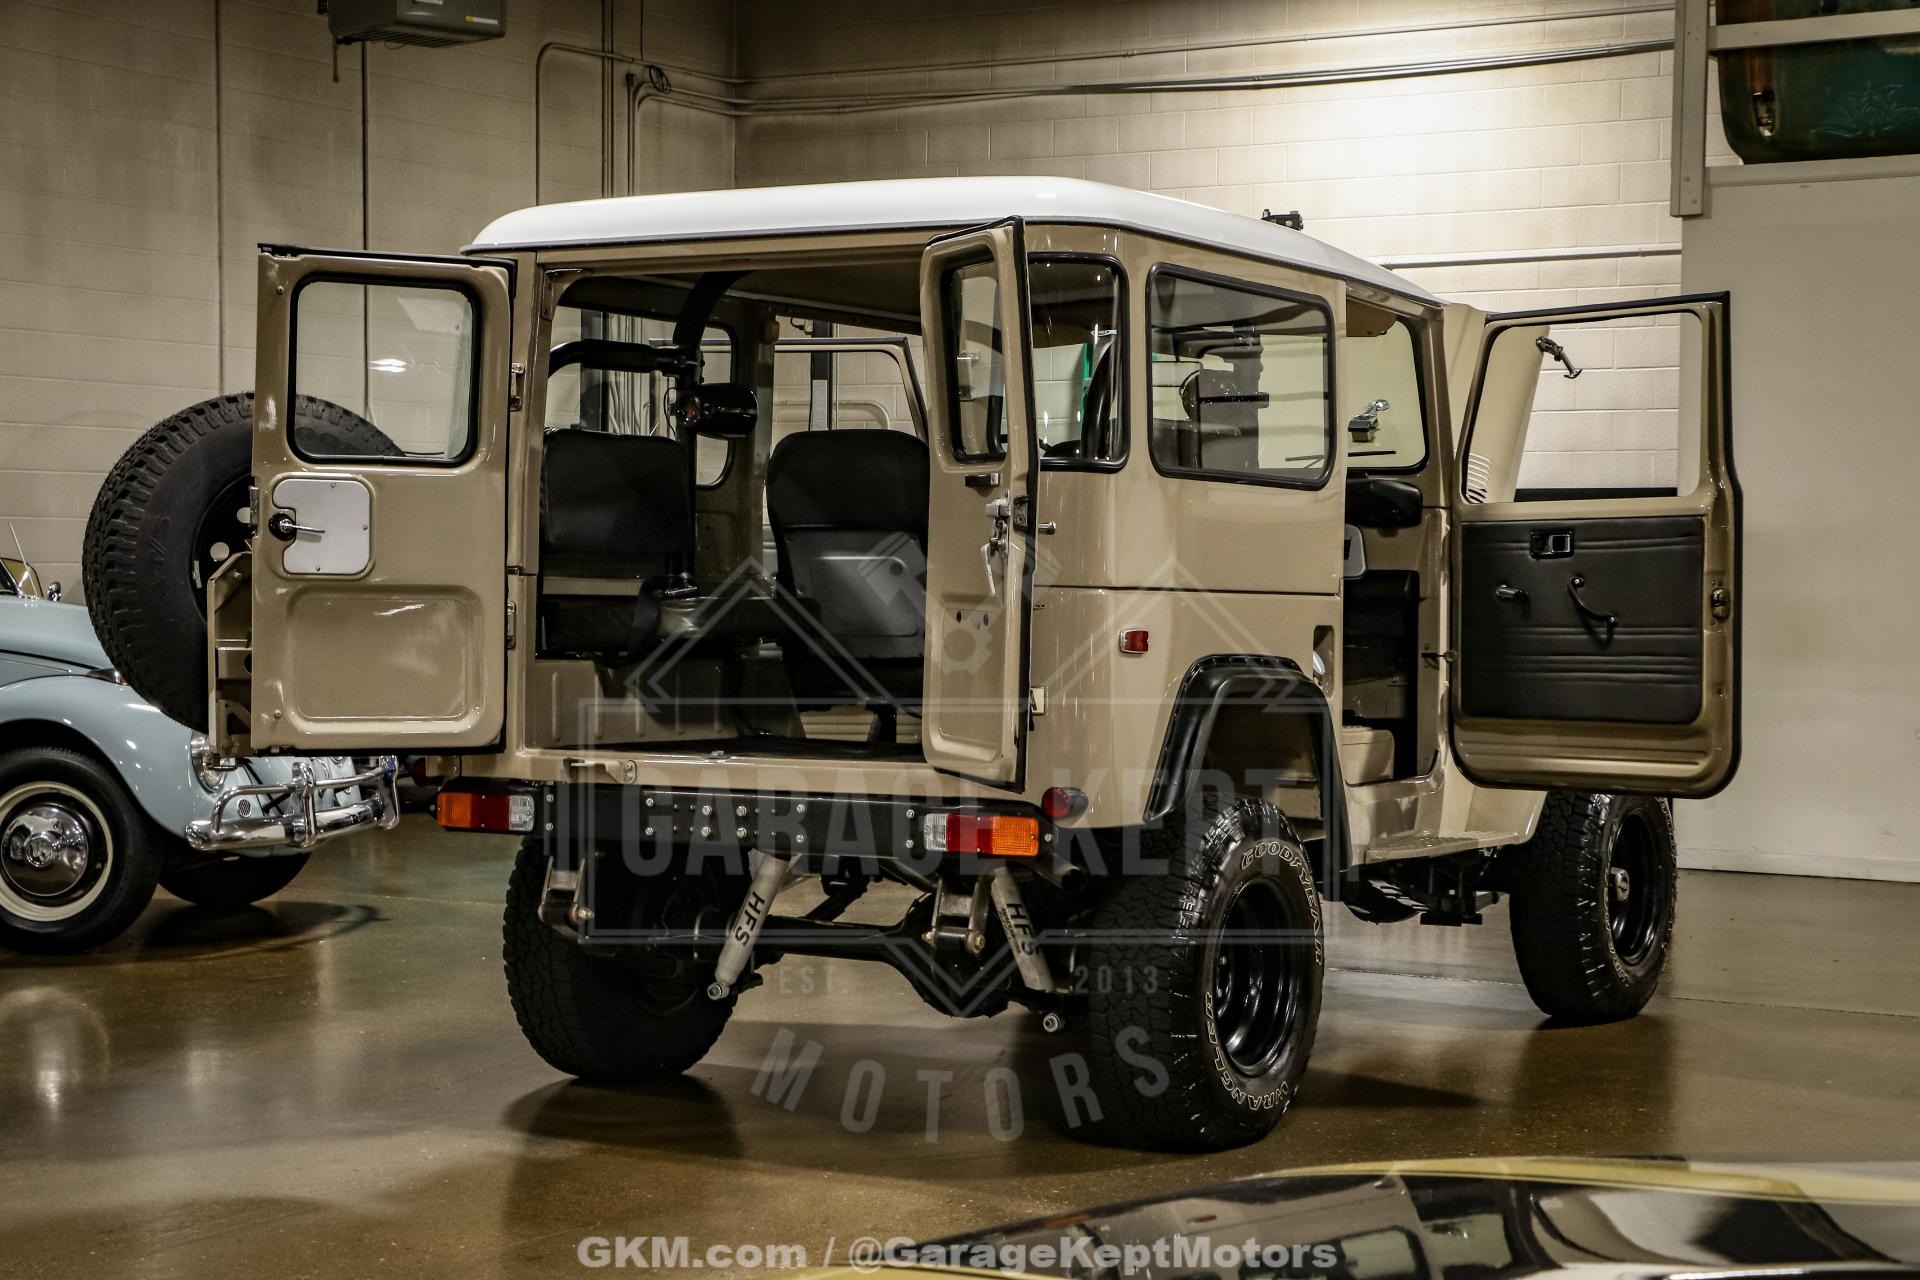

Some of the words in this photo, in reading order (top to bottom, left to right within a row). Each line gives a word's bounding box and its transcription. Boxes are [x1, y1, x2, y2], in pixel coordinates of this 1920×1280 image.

[735, 891, 766, 946] HFS
[1006, 903, 1040, 956] HFS
[1240, 841, 1324, 966] GOODYEAR
[1204, 991, 1289, 1111] WRANGLER
